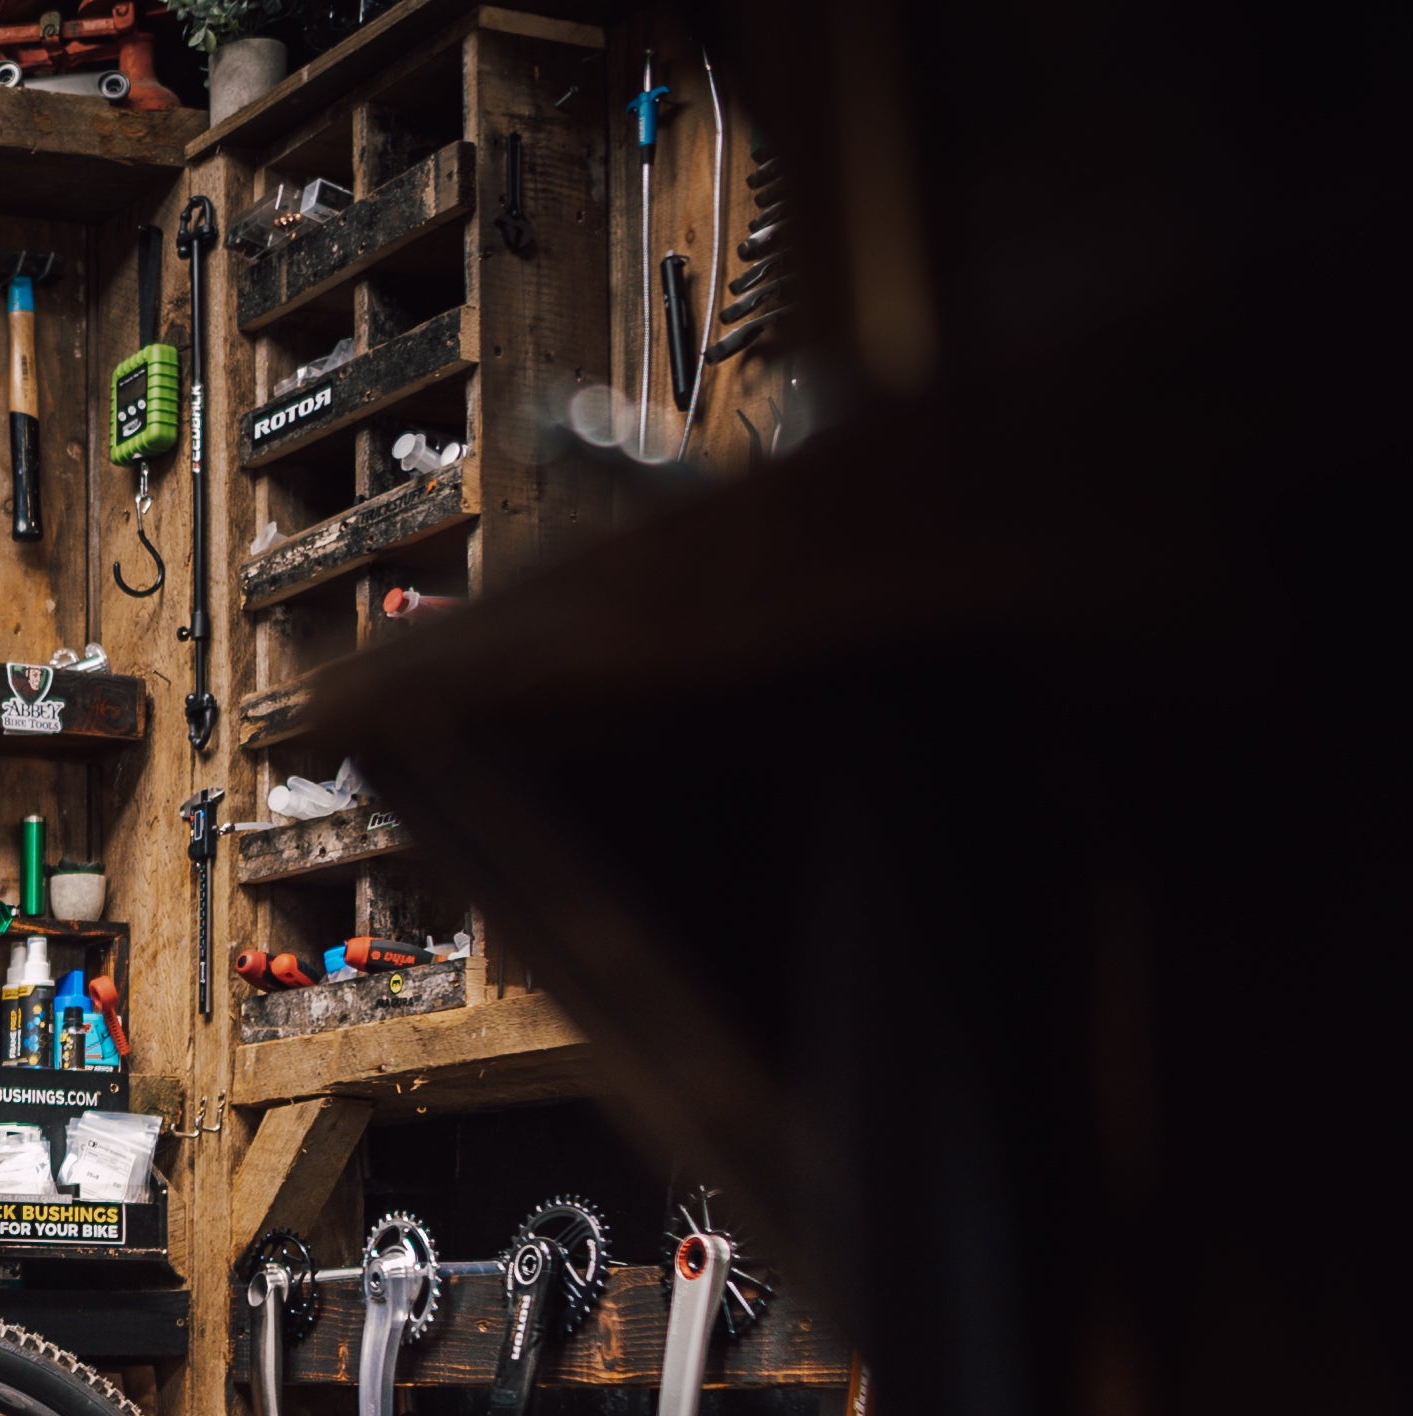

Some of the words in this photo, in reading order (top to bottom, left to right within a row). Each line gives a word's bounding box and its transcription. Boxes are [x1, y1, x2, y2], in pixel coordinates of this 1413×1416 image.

[254, 387, 333, 440] ROTOR
[3, 701, 62, 720] ABBEY
[4, 717, 27, 727] BIKE
[29, 719, 60, 730] TOOLS
[9, 1032, 18, 1058] FRAME
[23, 1205, 119, 1223] BUSHINGS
[0, 1222, 31, 1236] FOR
[34, 1223, 79, 1238] YOUR
[82, 1225, 119, 1239] BIKE
